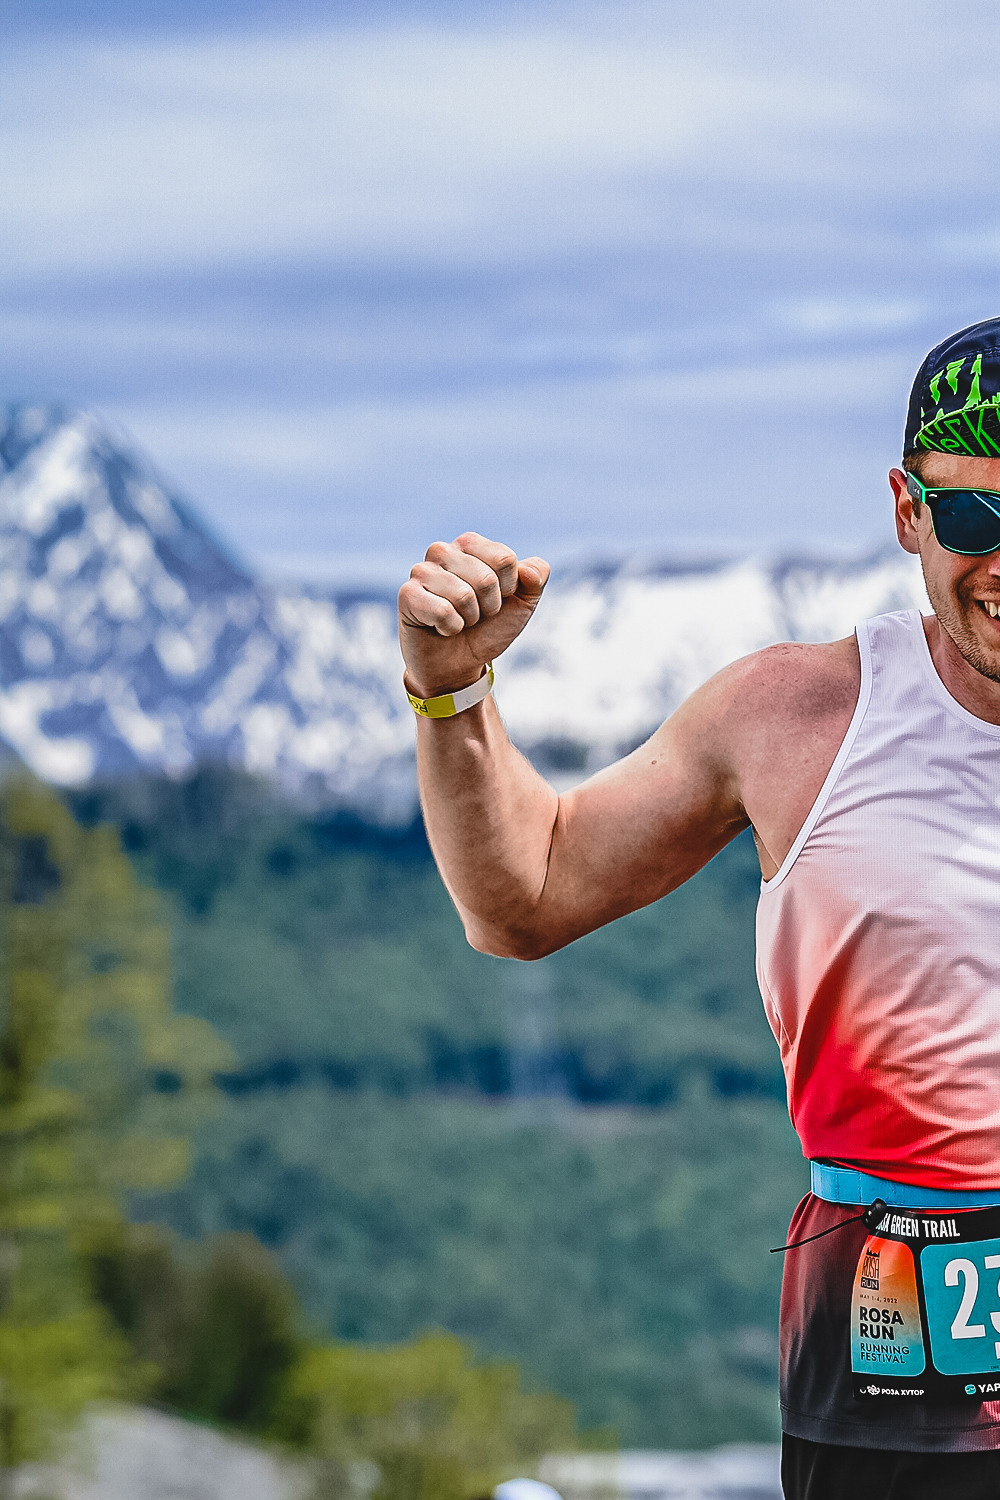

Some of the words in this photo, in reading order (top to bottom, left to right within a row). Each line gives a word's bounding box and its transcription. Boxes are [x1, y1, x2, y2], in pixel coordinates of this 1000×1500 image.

[890, 1214, 920, 1238] GREEN
[921, 1218, 961, 1238] TRAIL
[861, 1278, 878, 1289] RUN
[859, 1305, 905, 1325] ROSA
[859, 1322, 895, 1341] RUN
[860, 1342, 910, 1355] RUNNING
[860, 1352, 906, 1364] FESTIVAL
[881, 1388, 900, 1396] РОЗА
